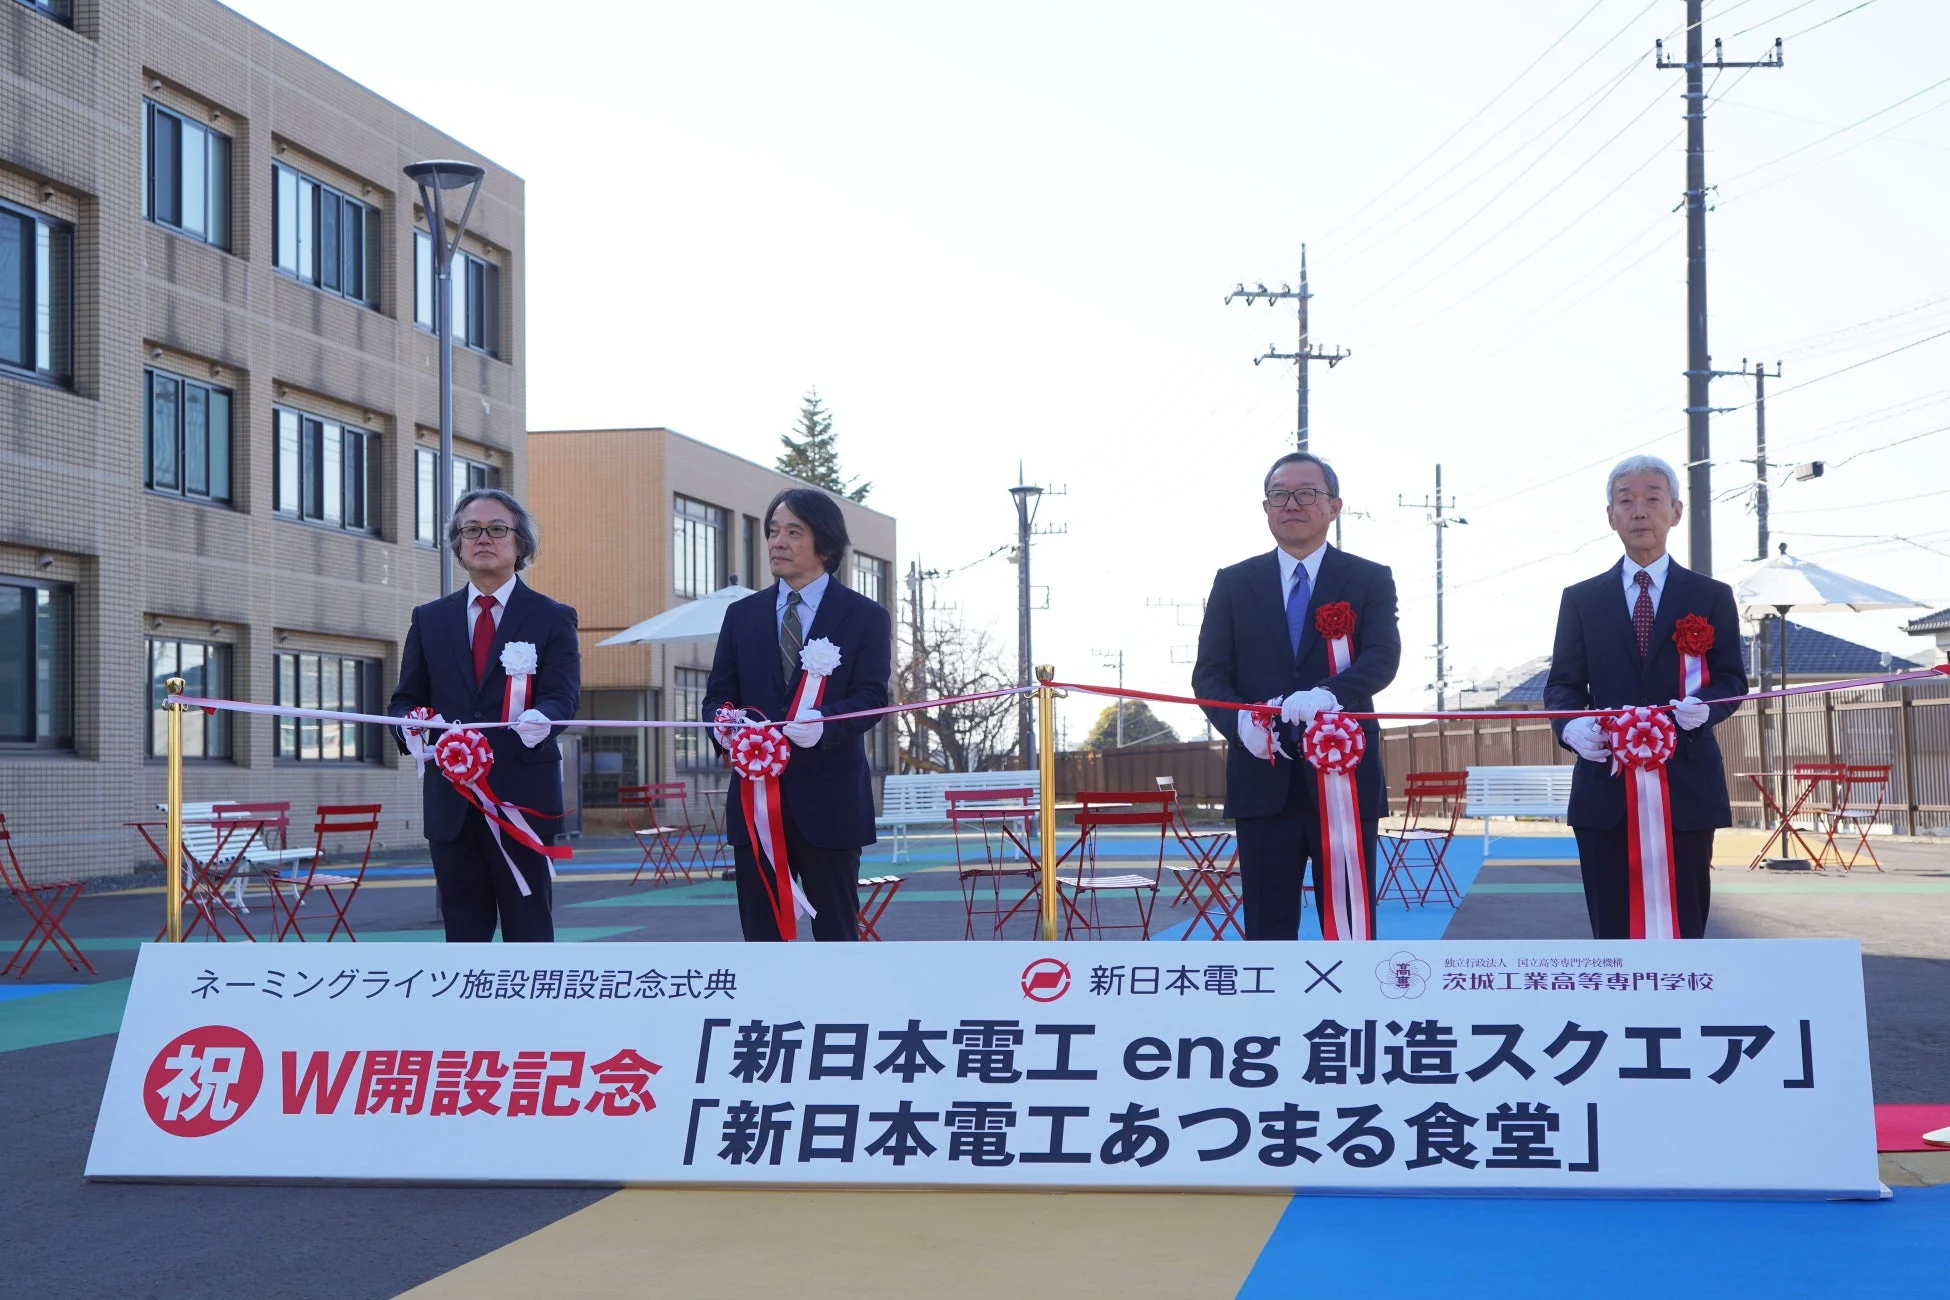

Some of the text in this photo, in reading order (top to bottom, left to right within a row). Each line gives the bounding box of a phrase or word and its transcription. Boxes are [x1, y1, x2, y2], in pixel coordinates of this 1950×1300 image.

[191, 968, 738, 1000] ネーミングライツ施設開設記念式典
[1089, 964, 1276, 996] 新日本電工
[1442, 971, 1714, 992] 茨城工業高等専門学校
[1444, 957, 1624, 969] 独立行政法人 国立高等専門学校機構
[694, 1017, 1815, 1089] 「新日本電工 eng 創造スクエア」
[154, 1043, 246, 1122] 祝
[281, 1048, 664, 1118] W開設記念
[682, 1098, 1600, 1173] 「新日本電工あつまる食堂」
